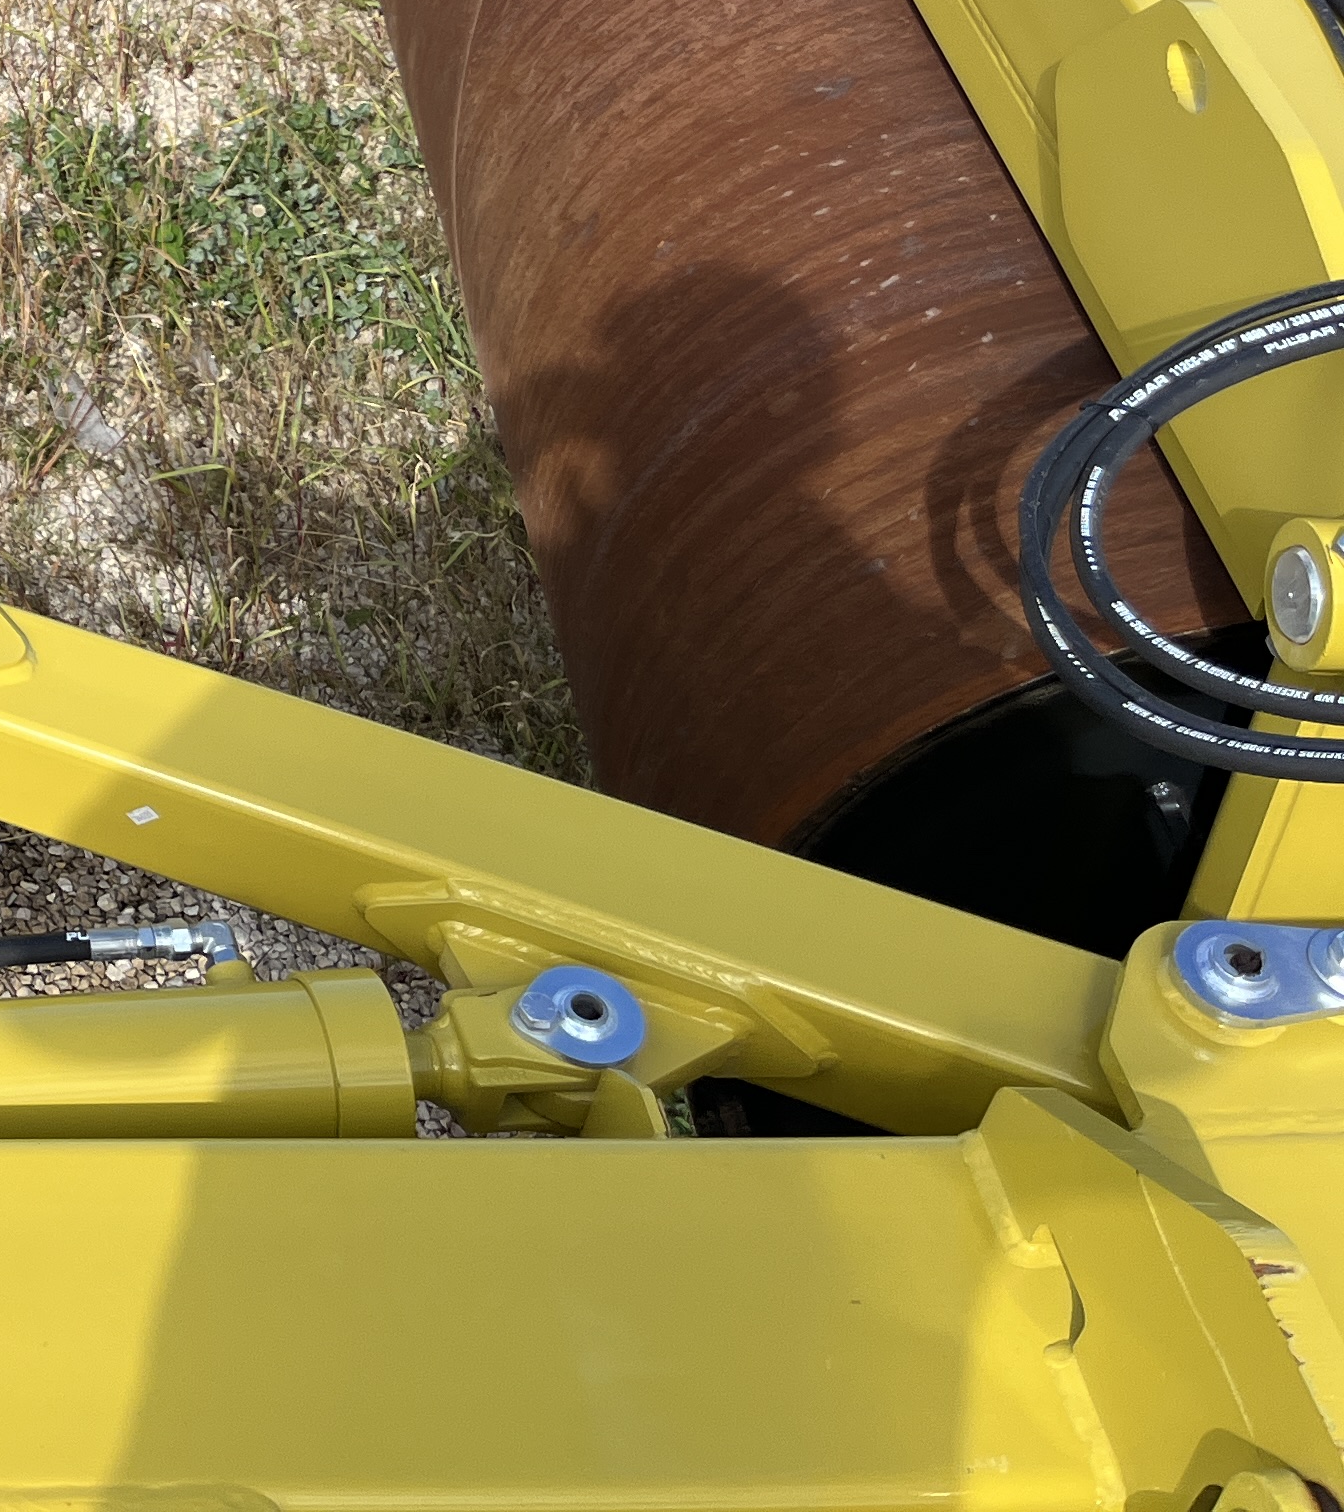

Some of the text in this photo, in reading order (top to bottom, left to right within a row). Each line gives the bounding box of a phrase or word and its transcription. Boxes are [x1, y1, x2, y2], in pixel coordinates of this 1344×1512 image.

[1263, 325, 1336, 354] PULSAR
[1108, 374, 1170, 422] PULSAR
[1236, 677, 1261, 689] SAE
[1260, 683, 1310, 700] EXCEEDS
